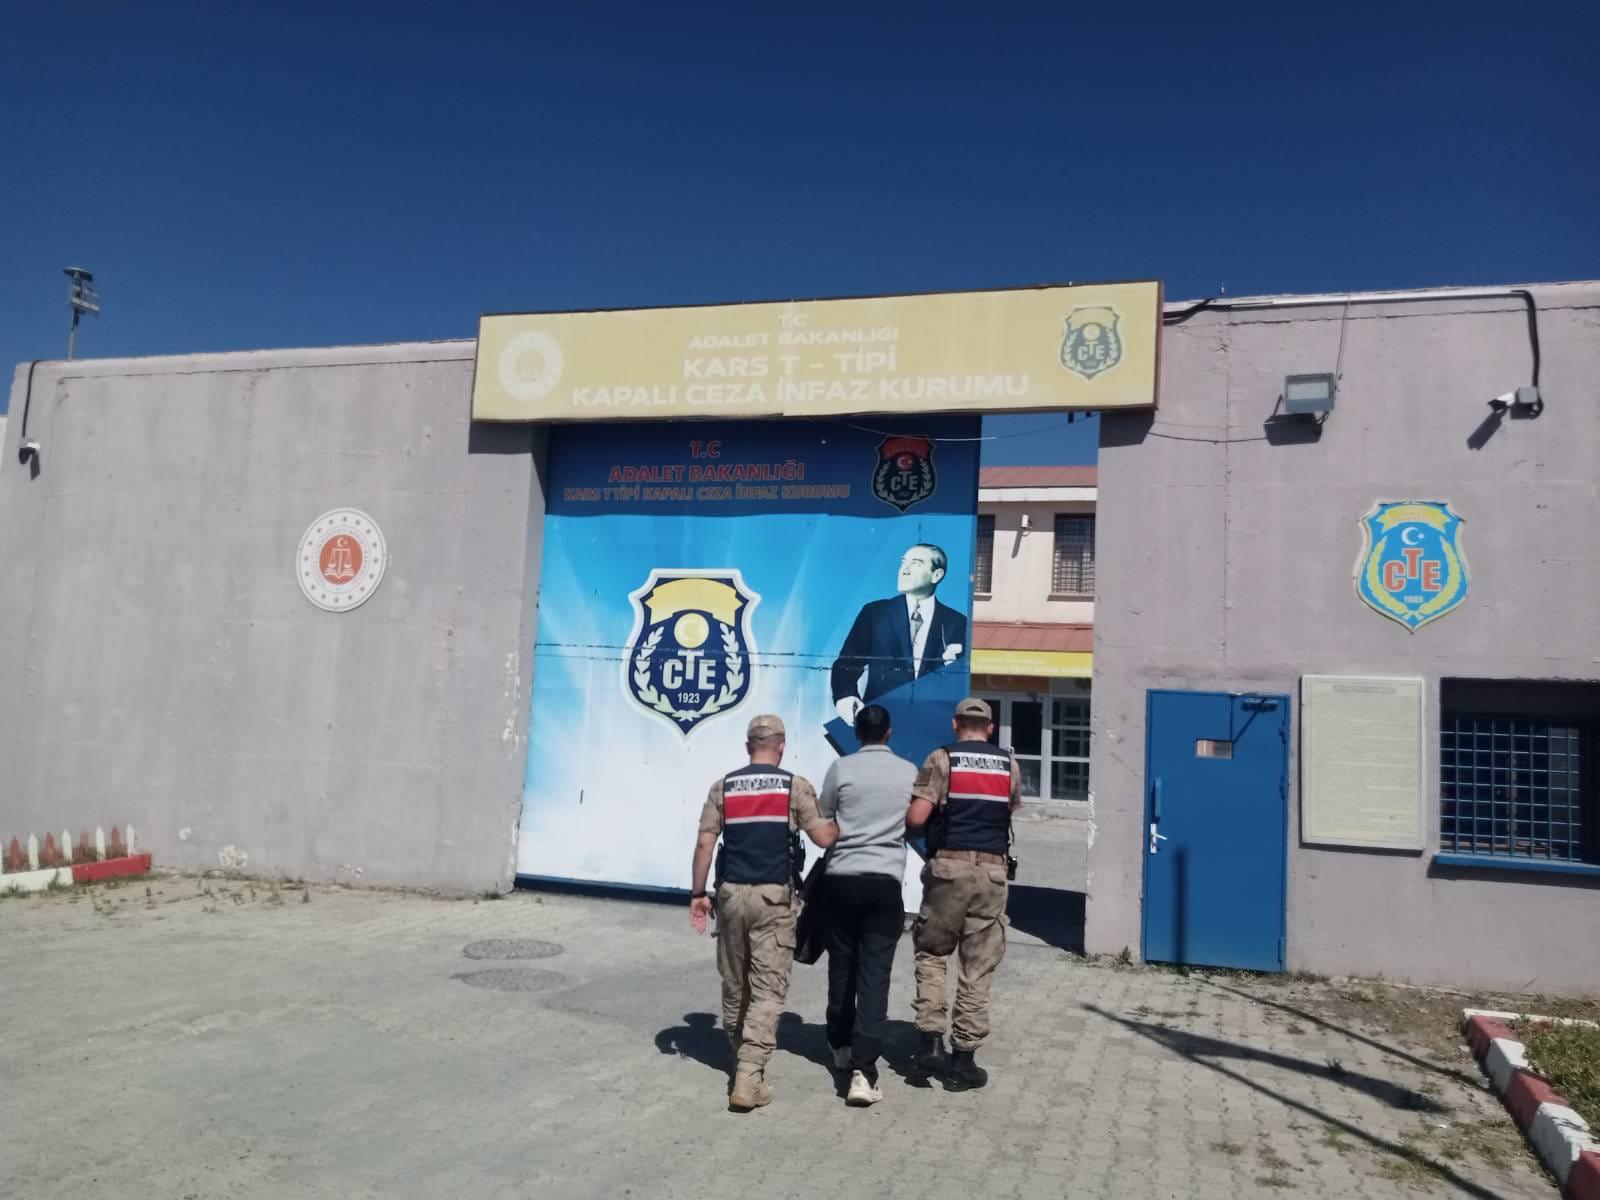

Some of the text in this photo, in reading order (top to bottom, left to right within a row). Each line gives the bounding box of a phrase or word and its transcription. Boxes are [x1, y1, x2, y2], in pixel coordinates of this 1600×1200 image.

[688, 325, 899, 349] ADALET BAKANLIĞI
[683, 355, 769, 379] KARS
[778, 354, 800, 376] T
[833, 346, 897, 374] TİPİ
[1077, 341, 1105, 361] CTE
[572, 373, 1030, 407] KAPALI CEZA İNFAZ KURUMU
[607, 459, 806, 482] ADALET BAKANLIĞI
[890, 471, 919, 491] CTE
[1382, 547, 1441, 592] CTE
[662, 649, 716, 690] CTE
[677, 692, 700, 704] 1923
[957, 755, 1004, 770] JANDARMA
[730, 777, 784, 792] JANDARMA
